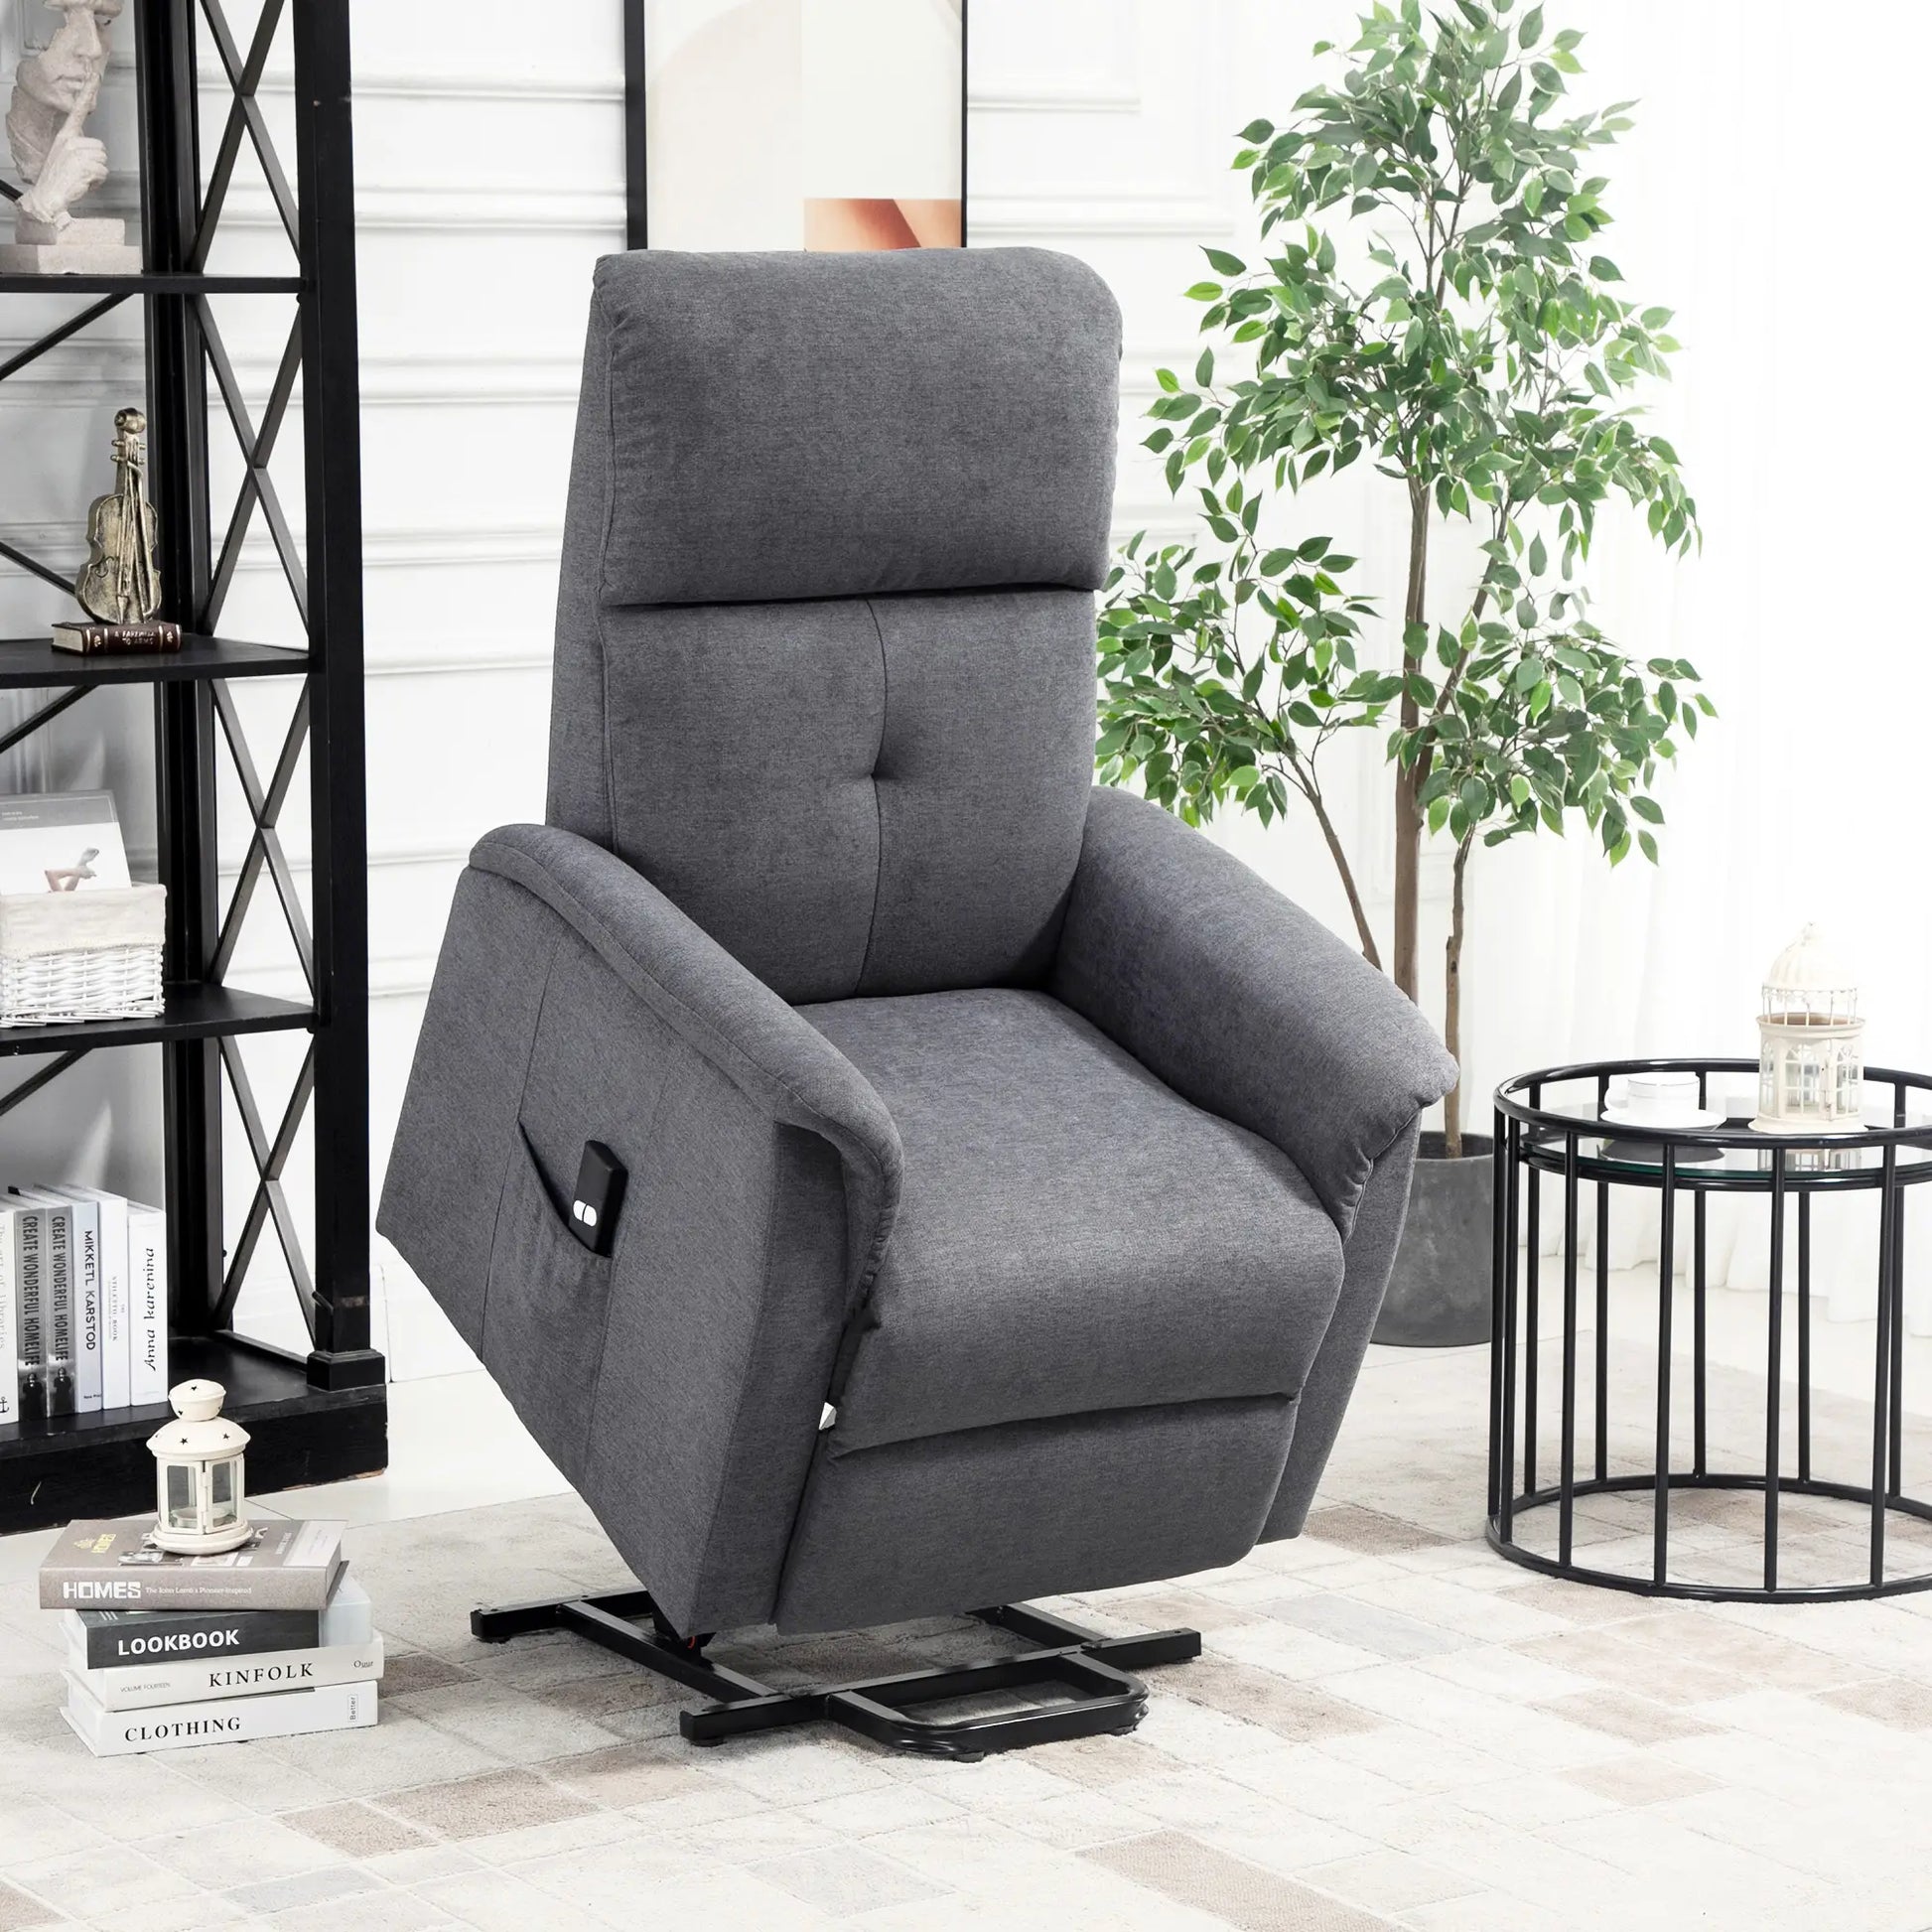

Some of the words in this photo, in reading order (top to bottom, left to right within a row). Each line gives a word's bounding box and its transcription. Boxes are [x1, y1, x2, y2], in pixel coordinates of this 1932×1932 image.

[22, 1216, 39, 1251] CREATE
[52, 1216, 66, 1250] CREATE
[84, 1230, 95, 1286] MIKKETL
[23, 1253, 40, 1315] WONDERFUL
[53, 1252, 68, 1311] WONDERFUL
[24, 1317, 41, 1366] HOMELIFE
[55, 1313, 69, 1361] HOMELIFE
[85, 1290, 96, 1351] KARSTOD
[144, 1329, 156, 1372] Anna
[63, 1581, 142, 1599] HOMES
[117, 1628, 240, 1657] LOOKBOOK
[208, 1662, 315, 1688] KINFOLK
[124, 1716, 241, 1742] CLOTHING
